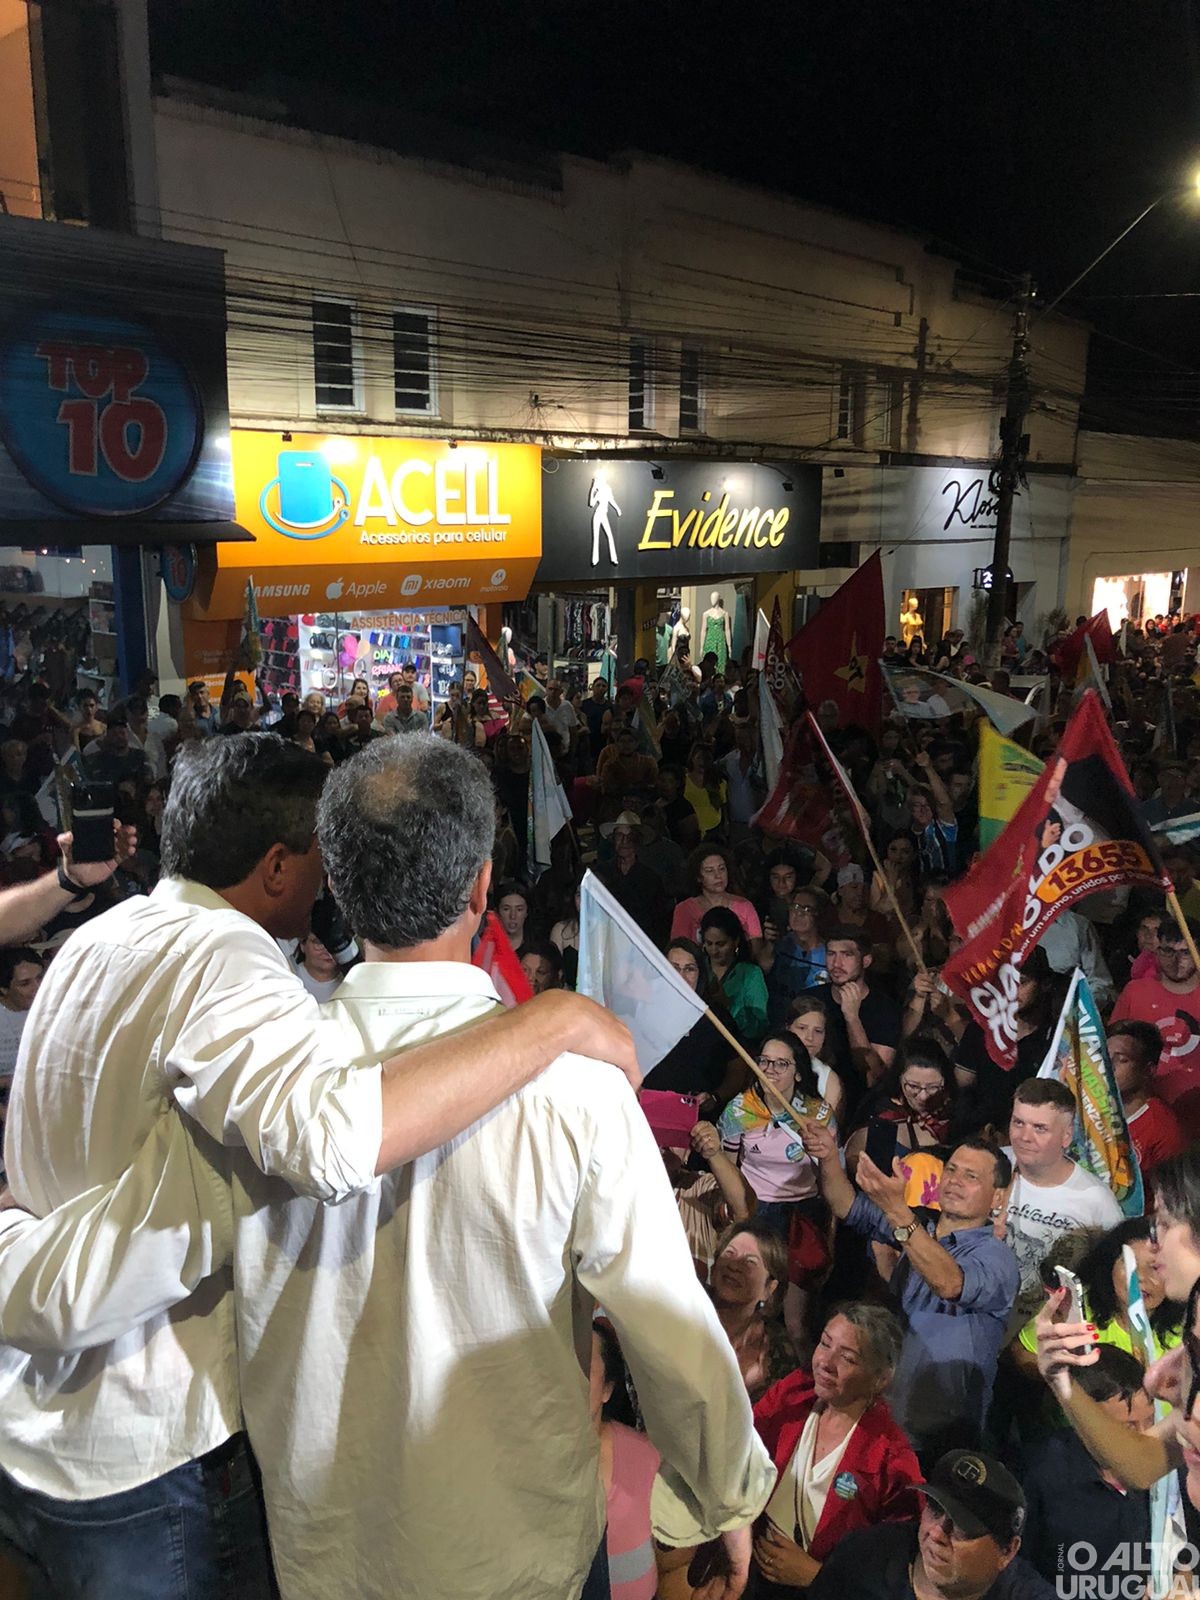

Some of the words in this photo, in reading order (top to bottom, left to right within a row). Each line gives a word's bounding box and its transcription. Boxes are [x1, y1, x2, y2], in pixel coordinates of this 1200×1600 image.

[35, 340, 149, 405] TOP
[56, 397, 168, 483] 10
[353, 455, 512, 526] ACELL
[360, 529, 432, 545] Acessórios
[433, 532, 463, 546] para
[466, 528, 508, 542] celular
[638, 490, 790, 550] Evidence
[345, 580, 388, 597] Apple
[423, 576, 472, 590] xiaomi
[351, 613, 421, 630] ASSISTÊNCIA
[423, 609, 470, 625] TÉCNICA
[373, 649, 391, 661] DIA
[1048, 843, 1144, 892] 13655
[1030, 921, 1044, 939] um
[1042, 891, 1073, 922] sonho,
[1070, 875, 1109, 896] unidos
[1008, 1203, 1075, 1232] alvador
